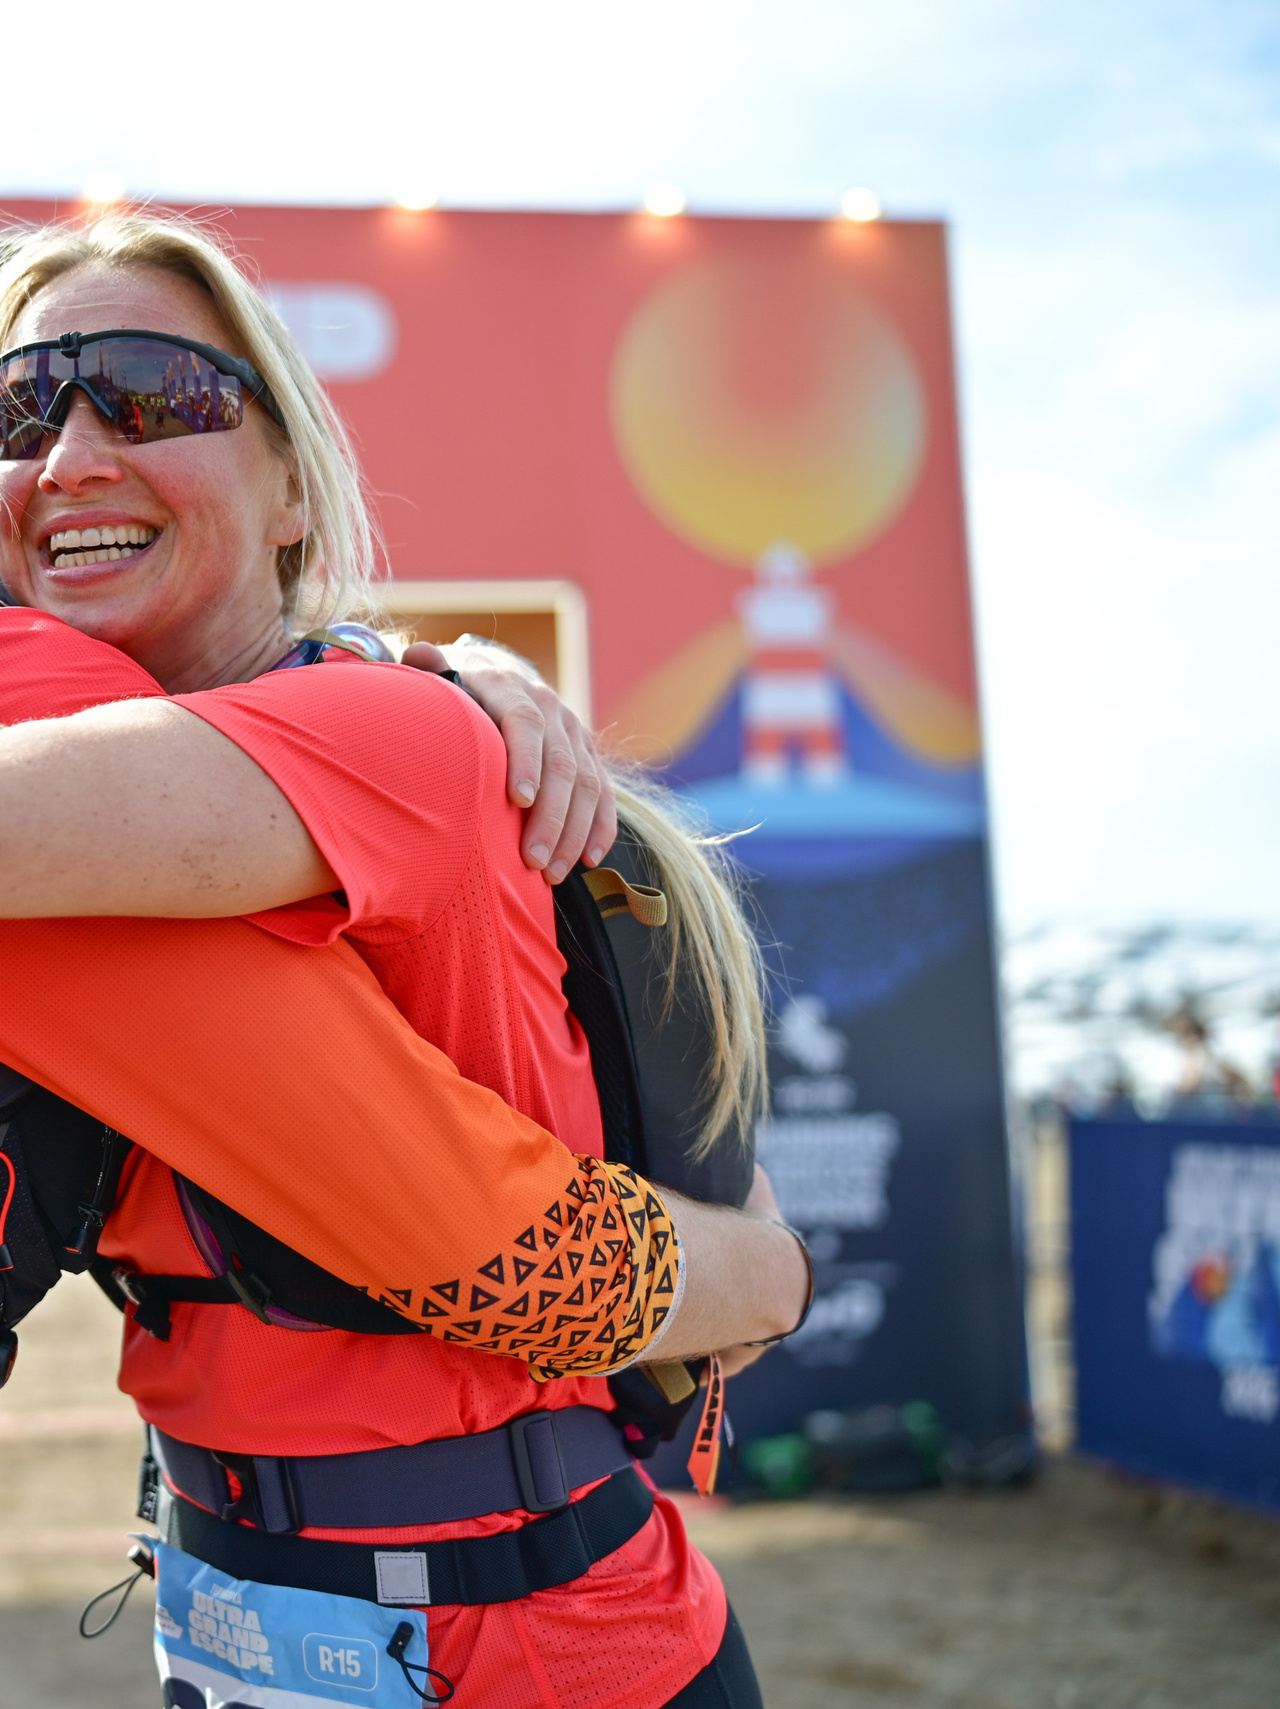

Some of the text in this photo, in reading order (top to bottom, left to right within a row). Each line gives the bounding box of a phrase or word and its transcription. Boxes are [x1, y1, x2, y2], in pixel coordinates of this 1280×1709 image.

[187, 1608, 269, 1654] GRAND
[192, 1588, 262, 1633] ULTRA
[188, 1625, 275, 1676] ESCAPE
[318, 1644, 361, 1678] R15
